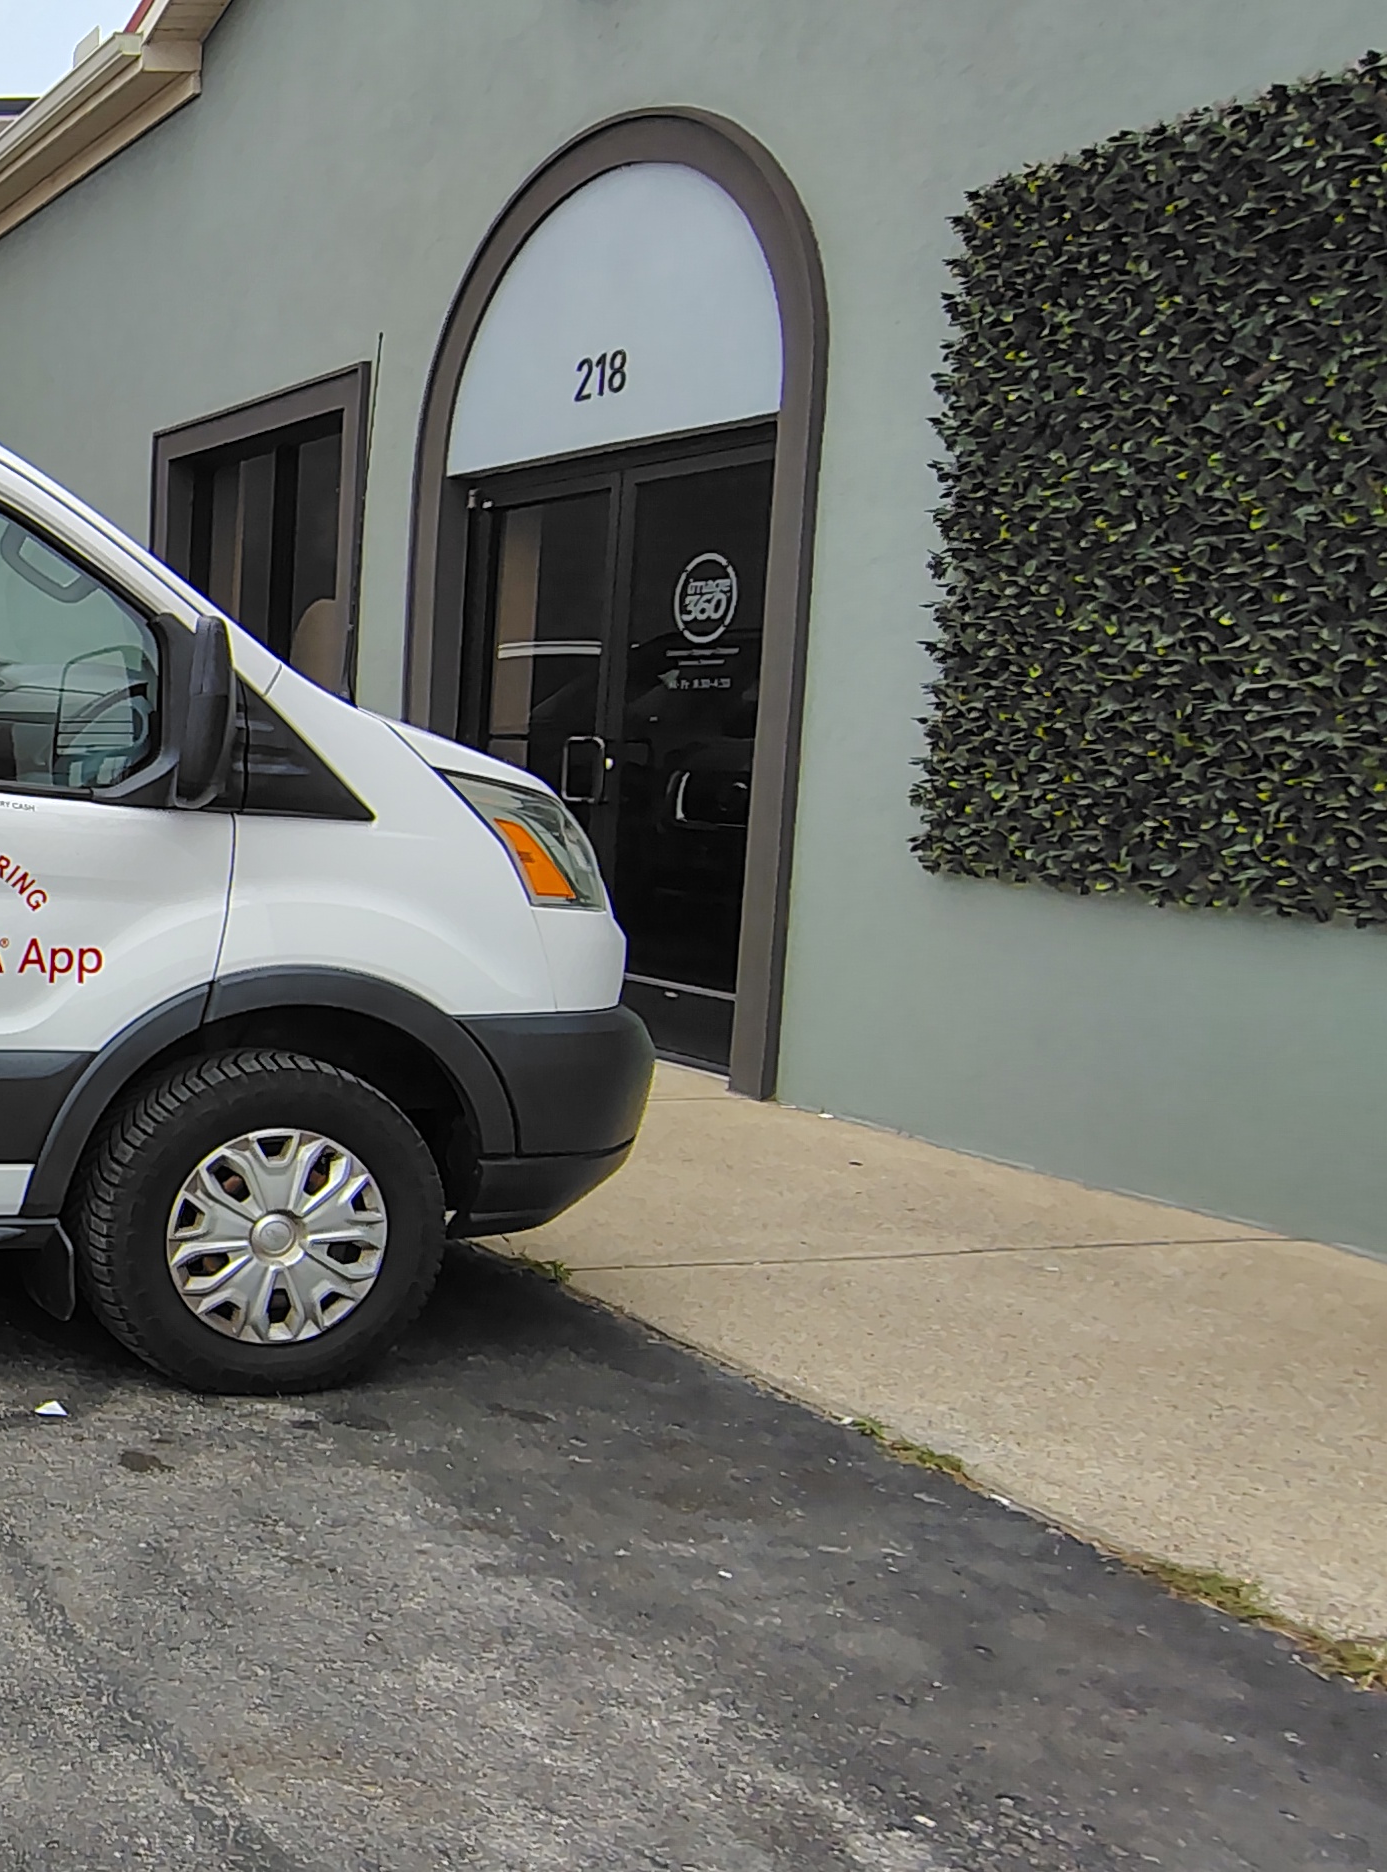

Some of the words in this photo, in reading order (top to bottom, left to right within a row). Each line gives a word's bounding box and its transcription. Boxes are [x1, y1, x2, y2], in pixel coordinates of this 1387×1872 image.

[574, 349, 626, 402] 218
[681, 591, 727, 621] 360
[12, 802, 35, 812] CASH
[18, 938, 104, 984] App
